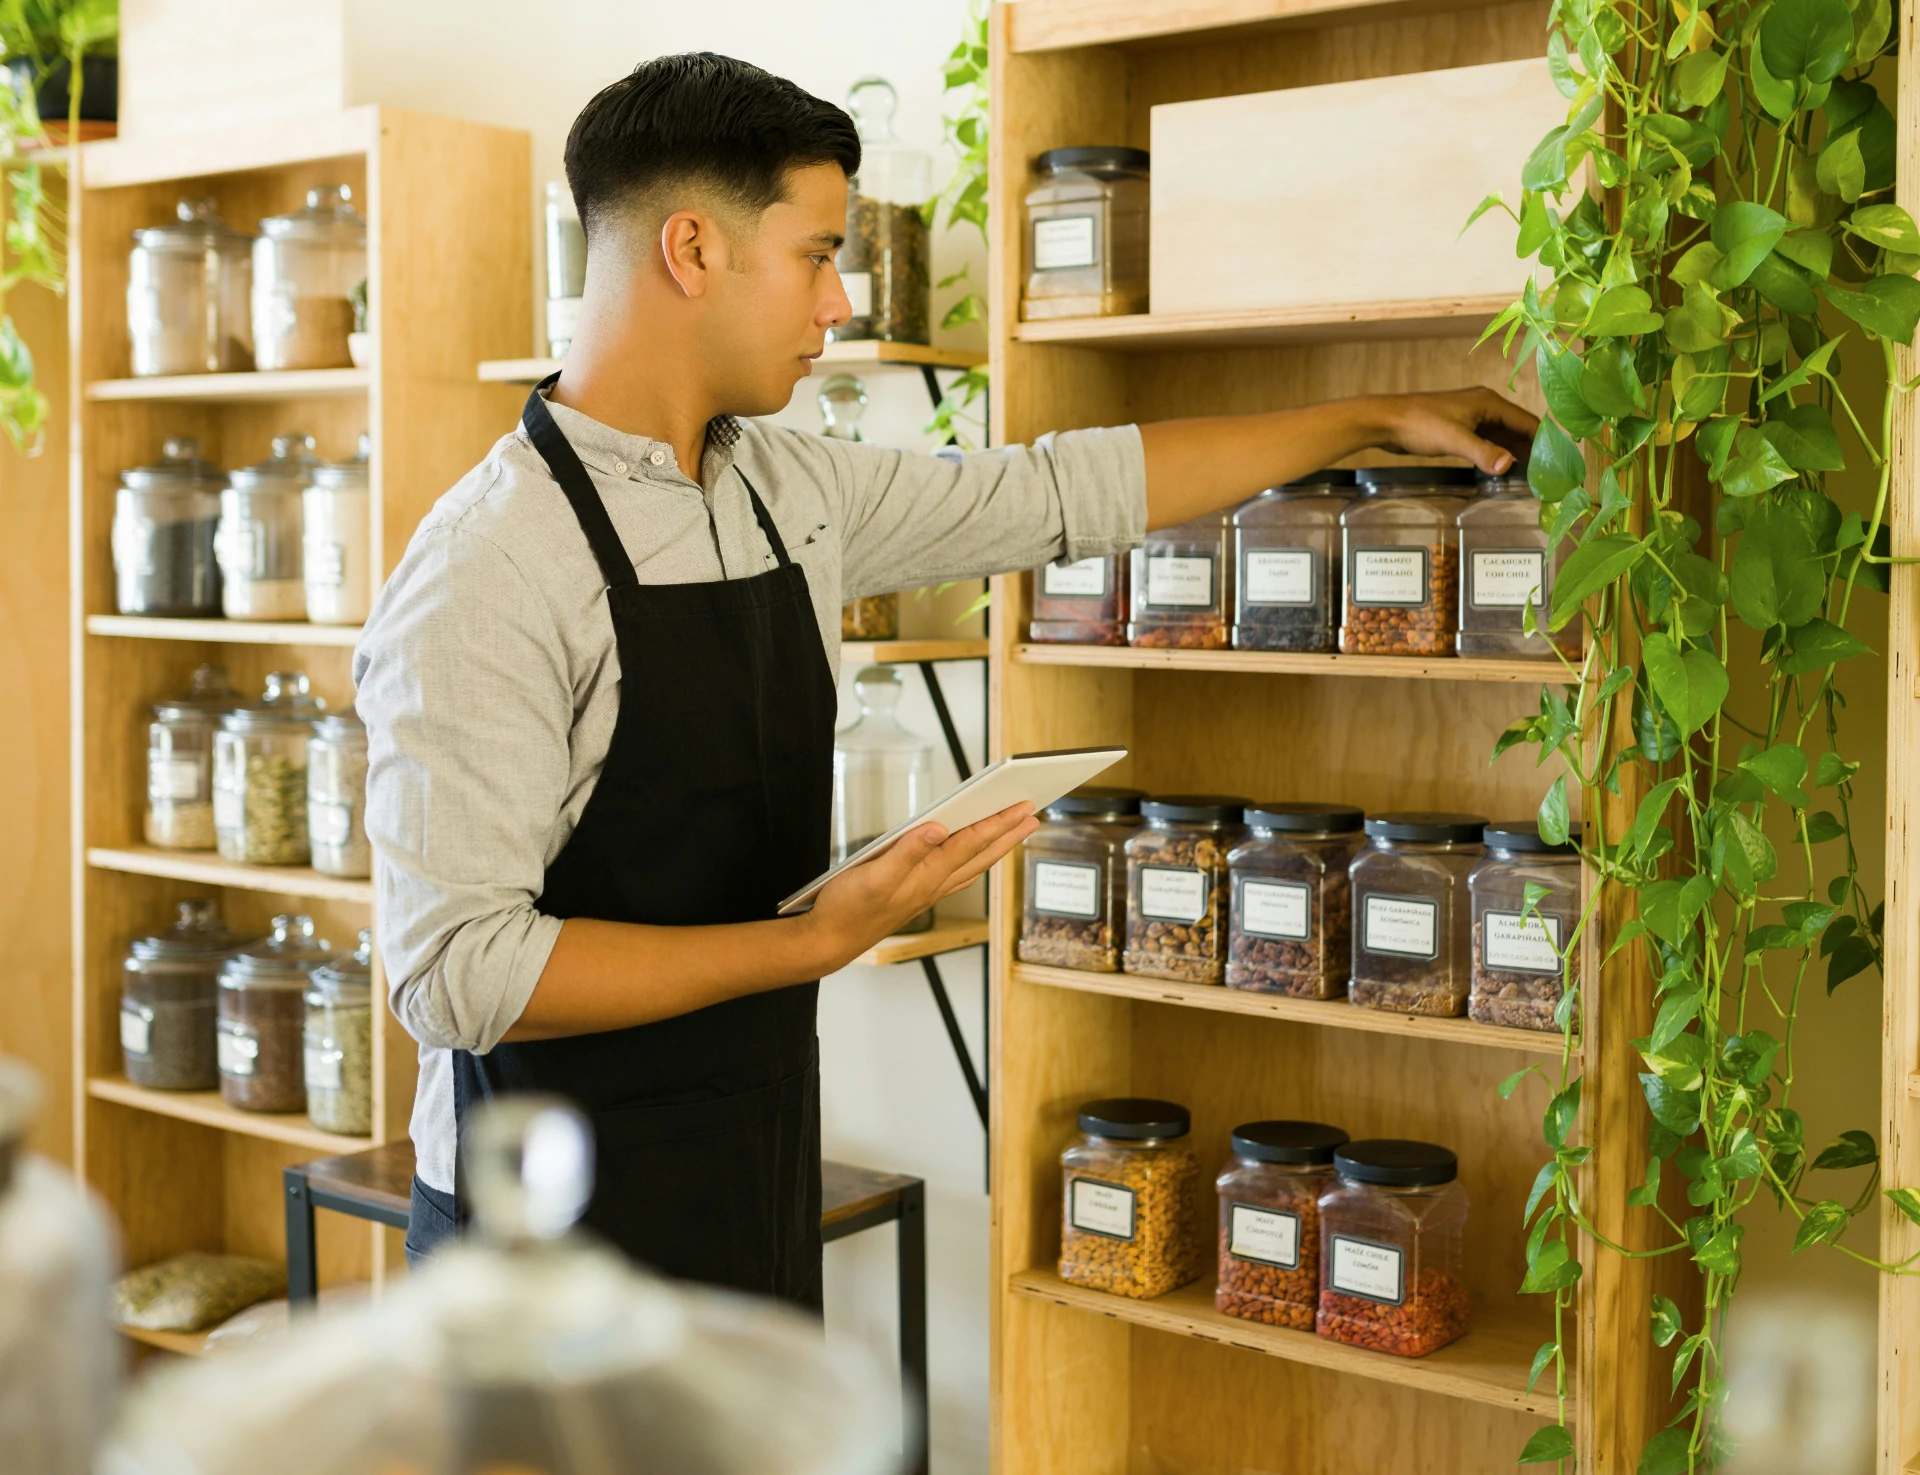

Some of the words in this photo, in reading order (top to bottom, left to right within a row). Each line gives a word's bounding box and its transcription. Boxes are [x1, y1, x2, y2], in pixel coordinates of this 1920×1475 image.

[1366, 556, 1412, 564] GARBANZO
[1483, 556, 1533, 565] CACAHUATE
[1365, 569, 1413, 577] ENCHILADO
[1485, 570, 1504, 578] CON
[1506, 570, 1531, 578] CHILE
[1494, 932, 1550, 943] GARAPIÑADA
